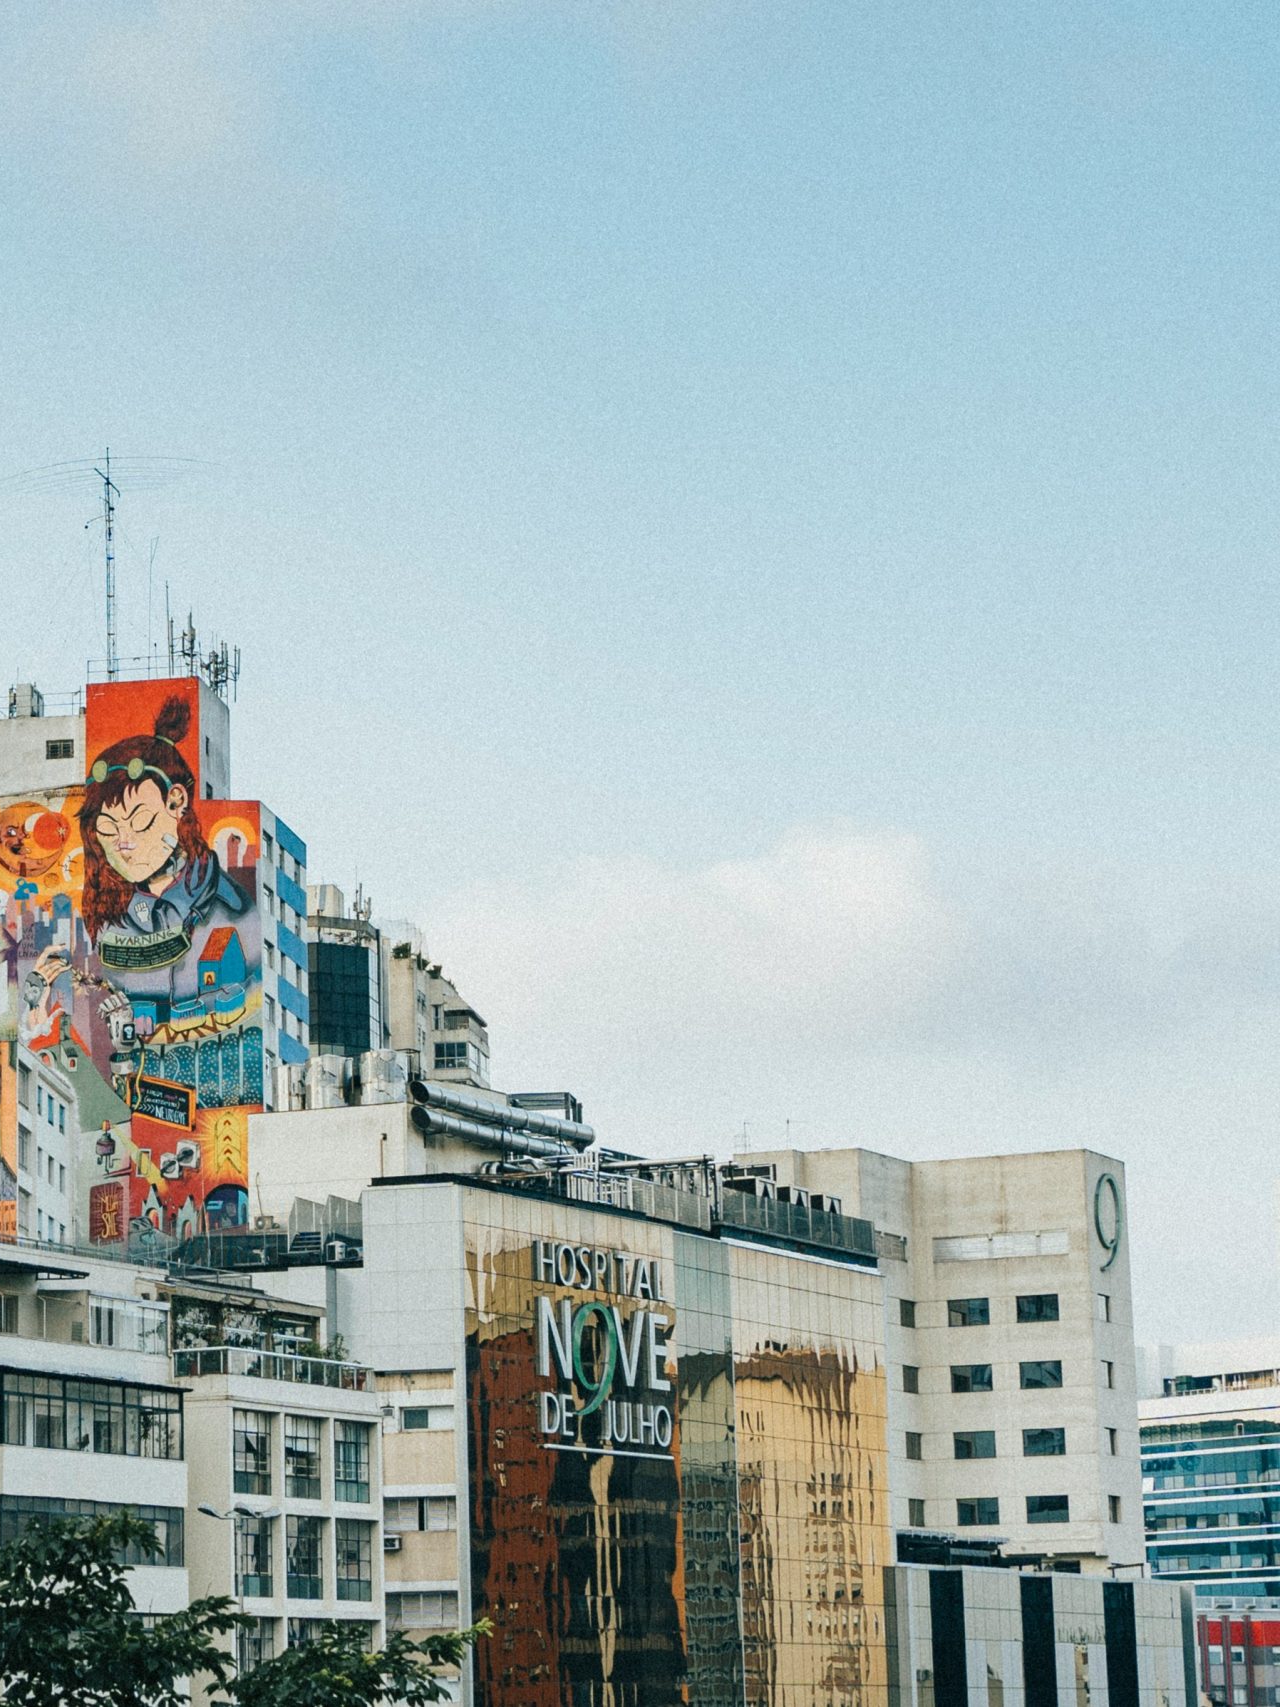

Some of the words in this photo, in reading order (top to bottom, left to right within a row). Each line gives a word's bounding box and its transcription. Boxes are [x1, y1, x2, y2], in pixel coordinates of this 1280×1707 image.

[114, 930, 176, 946] WARNING
[1094, 1172, 1122, 1273] 9
[533, 1240, 666, 1301] HOSPITAL
[540, 1391, 574, 1437] DE
[603, 1399, 673, 1448] JULHO
